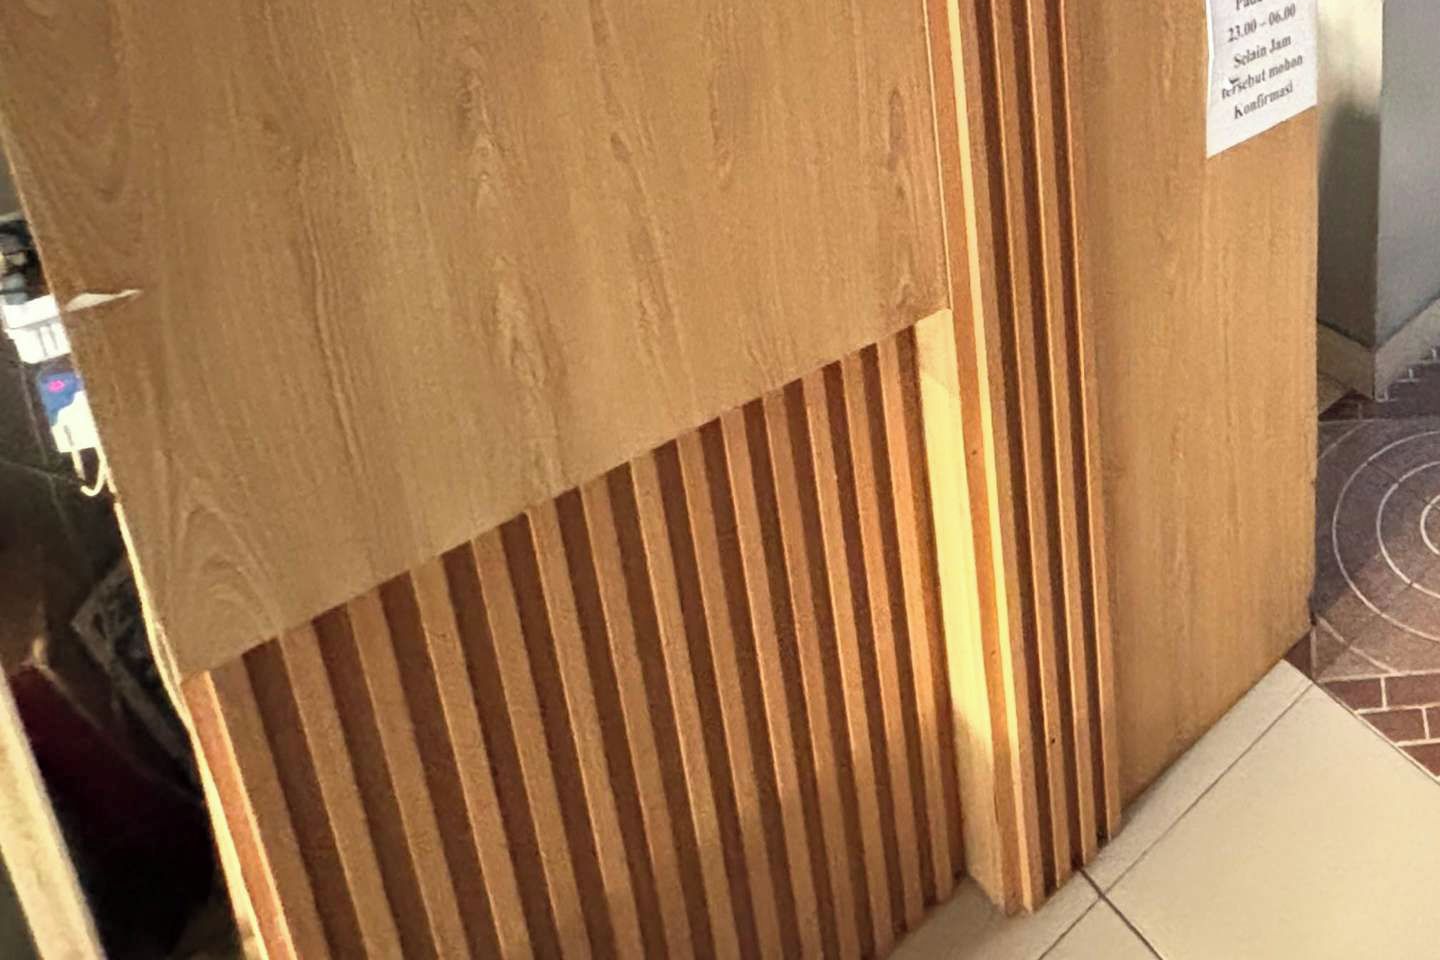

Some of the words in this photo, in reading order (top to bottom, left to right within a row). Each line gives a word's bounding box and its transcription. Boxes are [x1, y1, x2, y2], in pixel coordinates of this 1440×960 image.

[1228, 19, 1257, 42] 23.00
[1268, 3, 1296, 26] 06.00
[1233, 45, 1267, 68] Selain
[1269, 36, 1292, 53] Jam
[1221, 69, 1266, 99] tersebut
[1268, 55, 1303, 78] mohon
[1234, 80, 1293, 120] Konfirmasi
